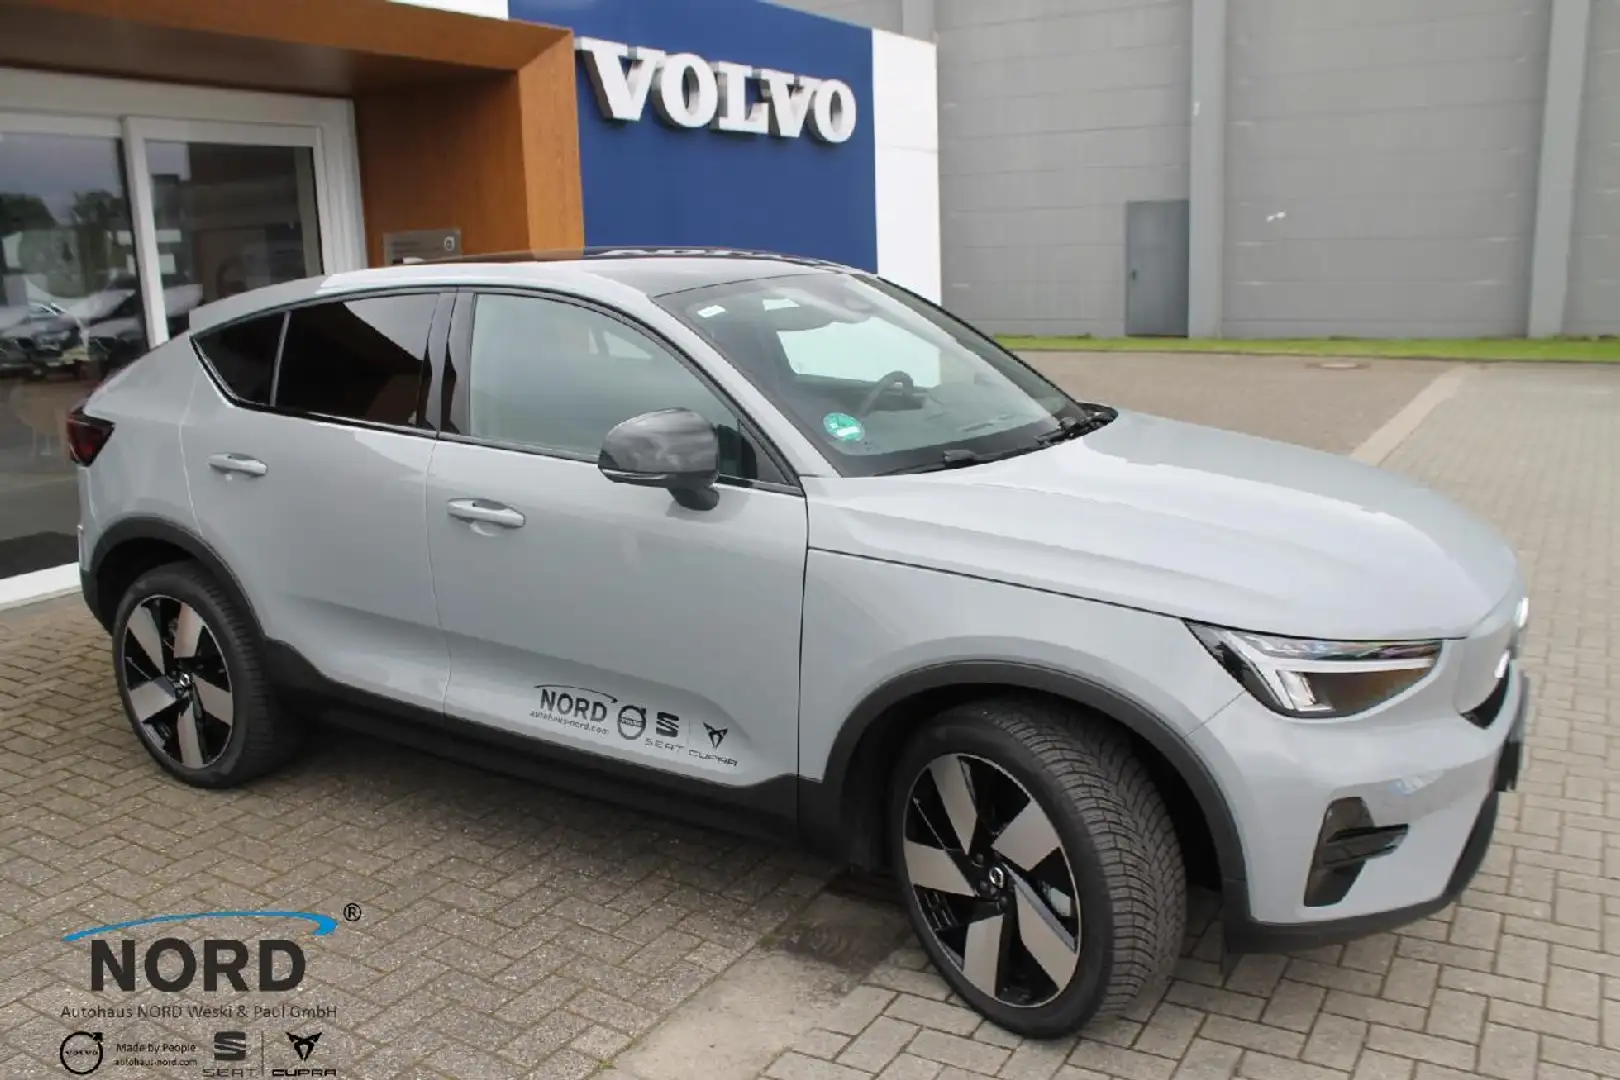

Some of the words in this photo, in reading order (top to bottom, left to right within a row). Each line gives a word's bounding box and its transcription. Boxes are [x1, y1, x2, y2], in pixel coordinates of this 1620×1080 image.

[575, 36, 857, 143] VOLVO
[540, 688, 607, 722] NORD
[645, 737, 685, 753] SEAT
